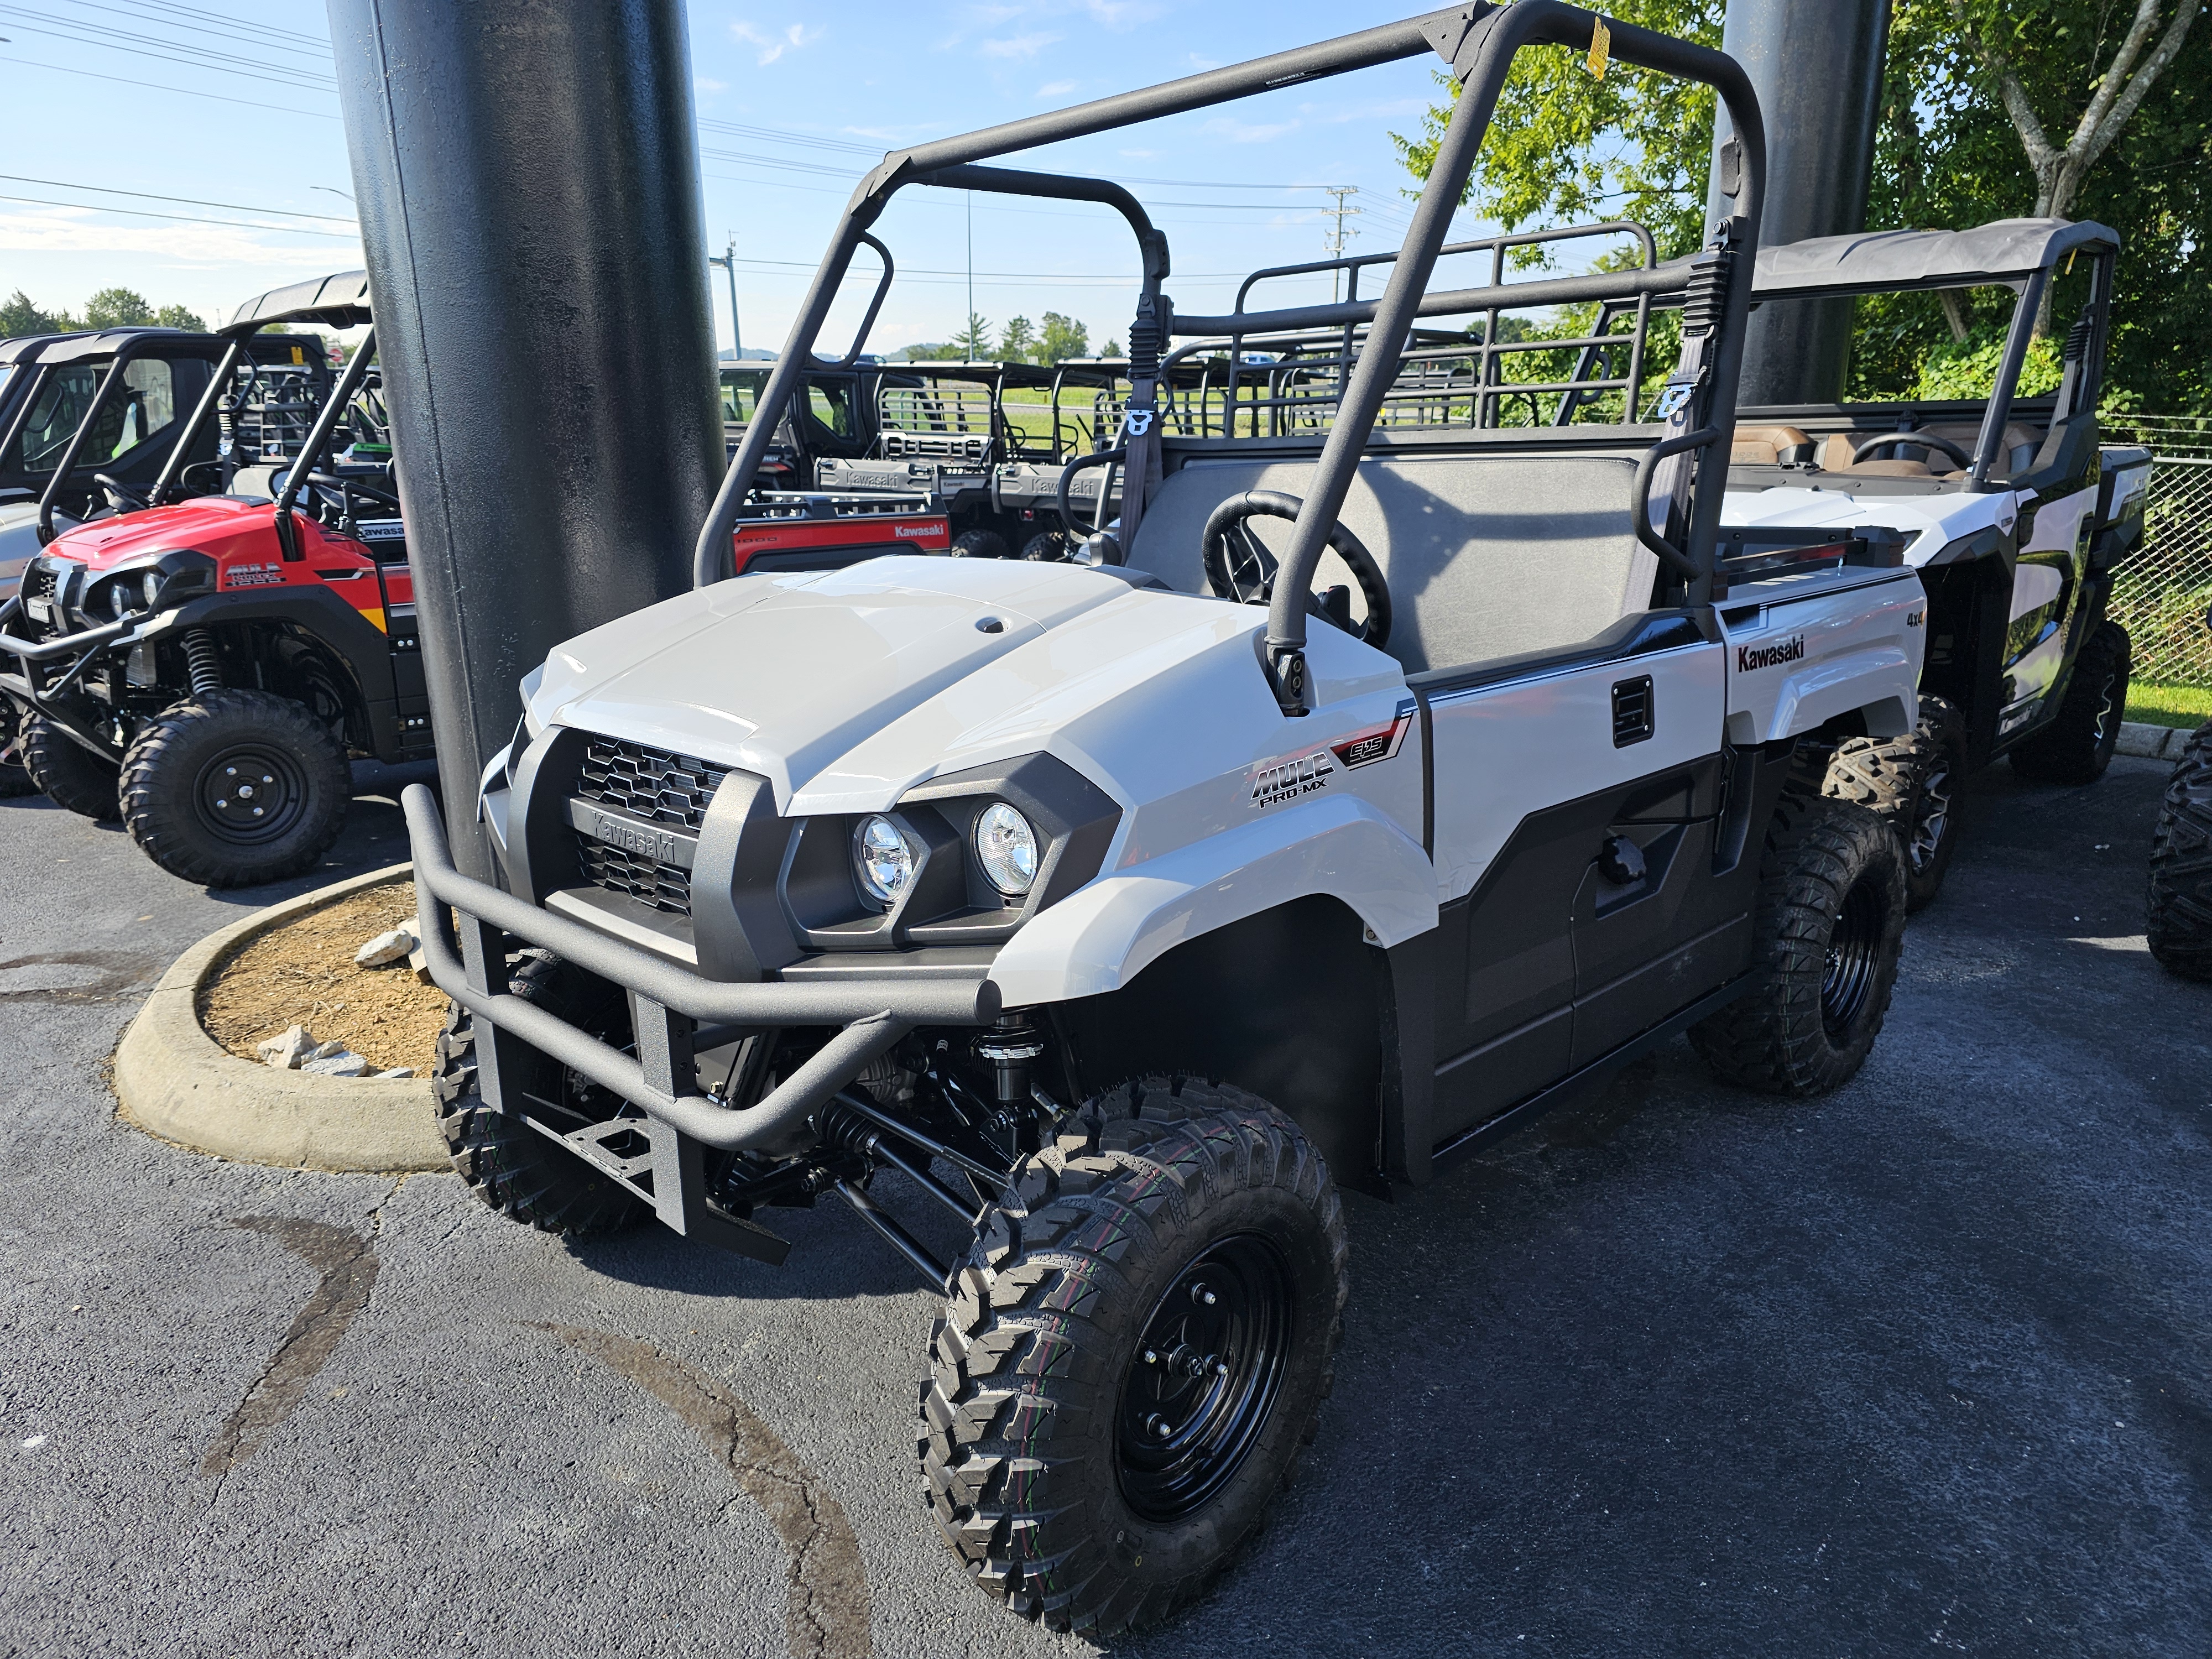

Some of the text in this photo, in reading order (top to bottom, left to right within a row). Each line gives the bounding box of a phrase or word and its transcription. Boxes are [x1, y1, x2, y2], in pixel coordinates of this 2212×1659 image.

[846, 471, 899, 489] Kawasaki
[1032, 478, 1093, 495] Kawaki
[363, 528, 404, 536] awasa
[895, 524, 944, 538] Kawasaki
[1907, 611, 1923, 628] 4x4
[1738, 634, 1804, 673] Kawasaki
[1350, 736, 1383, 757] EPS
[1250, 752, 1335, 800] MULE
[1258, 777, 1329, 810] PRO-MX
[592, 811, 675, 864] Kawasaki
